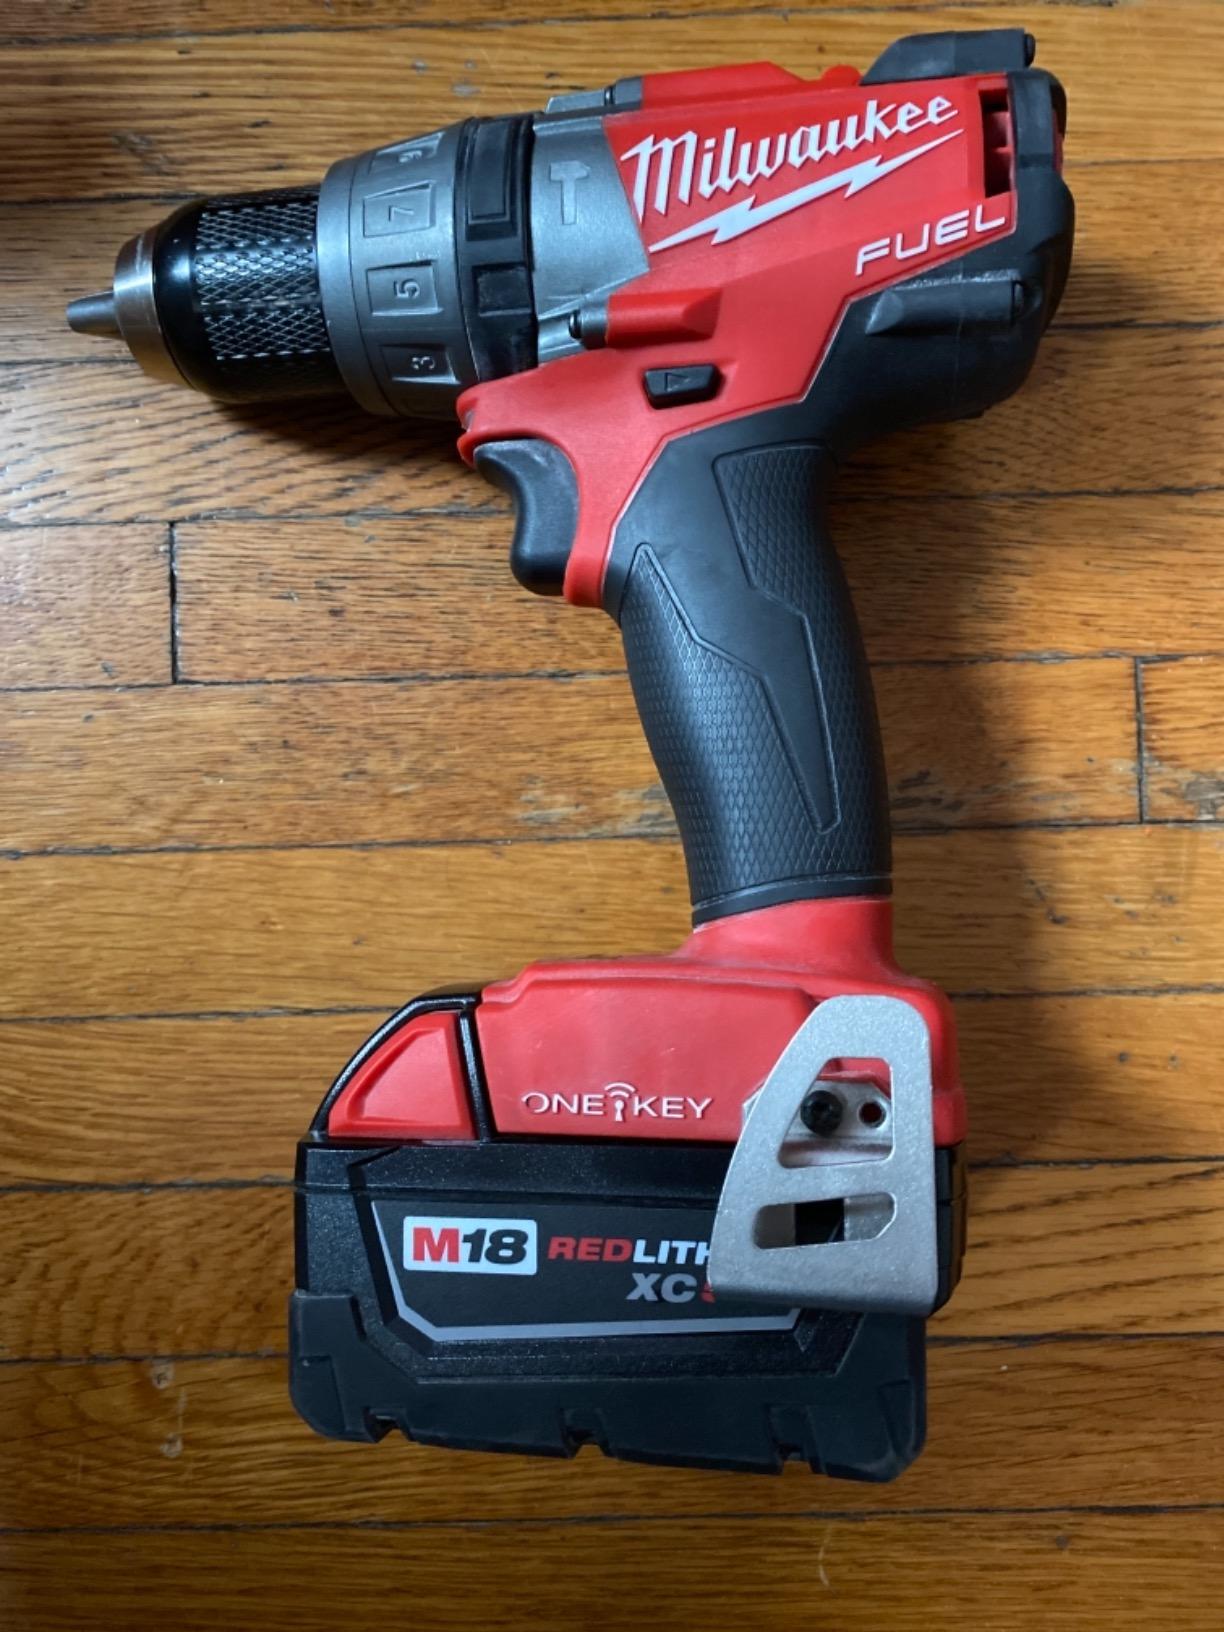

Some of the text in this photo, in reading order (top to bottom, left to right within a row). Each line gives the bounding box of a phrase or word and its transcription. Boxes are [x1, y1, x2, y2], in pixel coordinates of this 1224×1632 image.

[620, 96, 958, 223] Milwaukee
[388, 205, 415, 222] 7
[855, 205, 1006, 275] FUEL
[394, 278, 420, 298] 5
[411, 355, 436, 371] 3
[412, 1227, 529, 1266] M18
